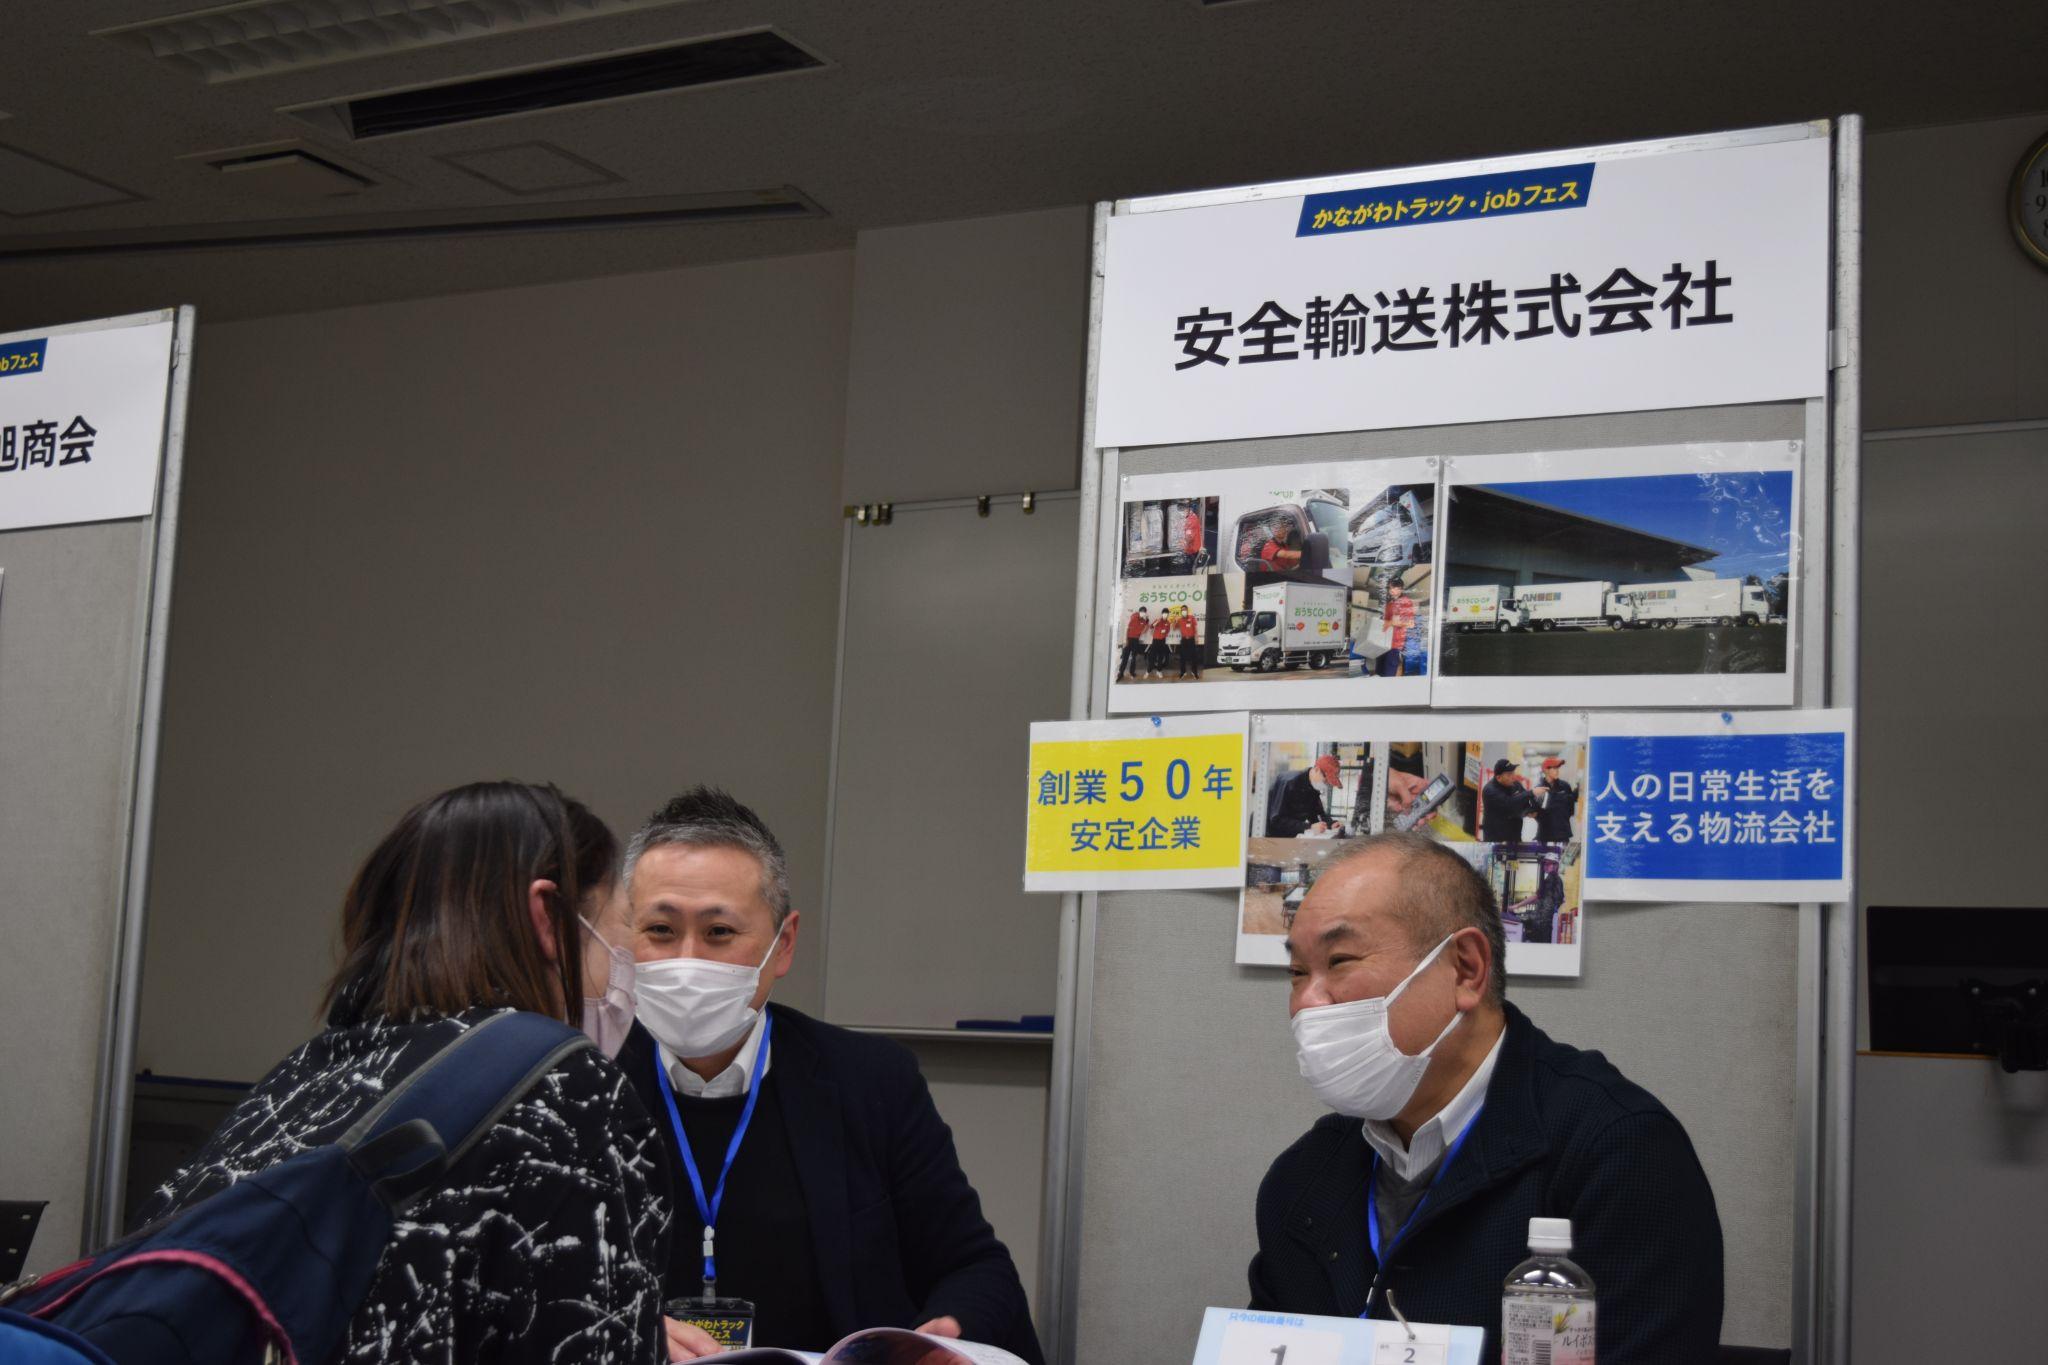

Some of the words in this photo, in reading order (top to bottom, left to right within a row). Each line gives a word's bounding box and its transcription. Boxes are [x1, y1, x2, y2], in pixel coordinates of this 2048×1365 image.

[1312, 181, 1578, 229] かながわトラック・jobフェス
[1174, 259, 1734, 371] 安全輸送株式会社
[0, 352, 39, 372] bフェス
[1037, 758, 1234, 806] 創業50年
[1596, 768, 1834, 802] 人の日常生活を
[1071, 816, 1200, 852] 安定企業
[1595, 810, 1836, 844] 支える物流会社
[1403, 1347, 1416, 1363] 2
